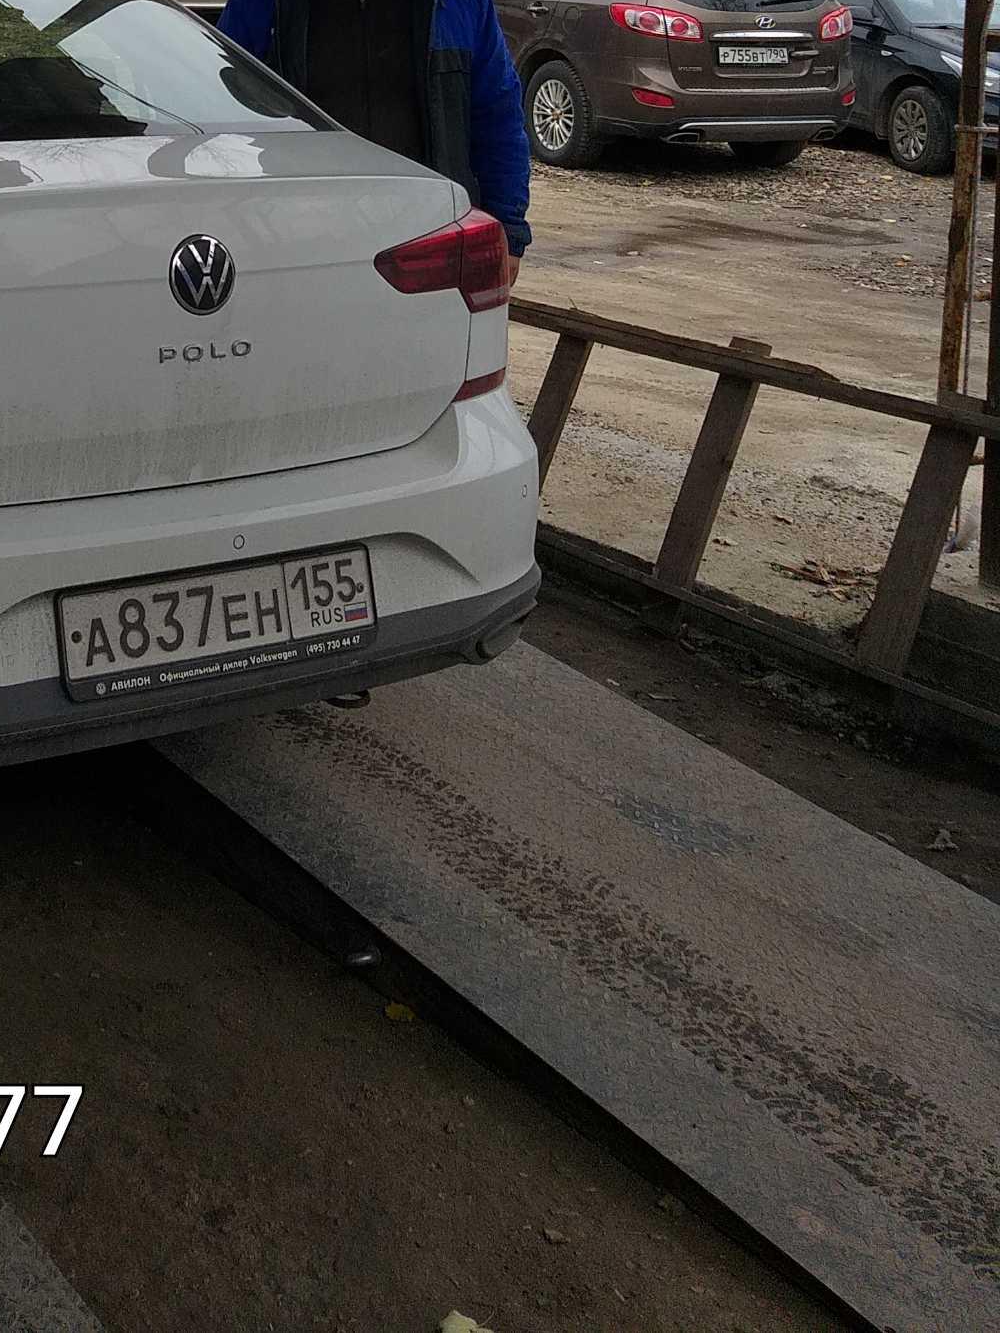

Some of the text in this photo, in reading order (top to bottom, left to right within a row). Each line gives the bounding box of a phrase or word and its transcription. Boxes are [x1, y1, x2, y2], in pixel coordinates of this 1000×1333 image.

[158, 340, 252, 364] POLO
[86, 559, 358, 668] А837ЕН 155
[311, 607, 344, 628] RUS
[110, 677, 151, 693] АВИЛОН
[159, 663, 221, 683] Официальный
[222, 659, 249, 673] дилер
[249, 650, 298, 666] Volkswagen
[306, 643, 326, 656] (495)
[327, 640, 341, 651] 730
